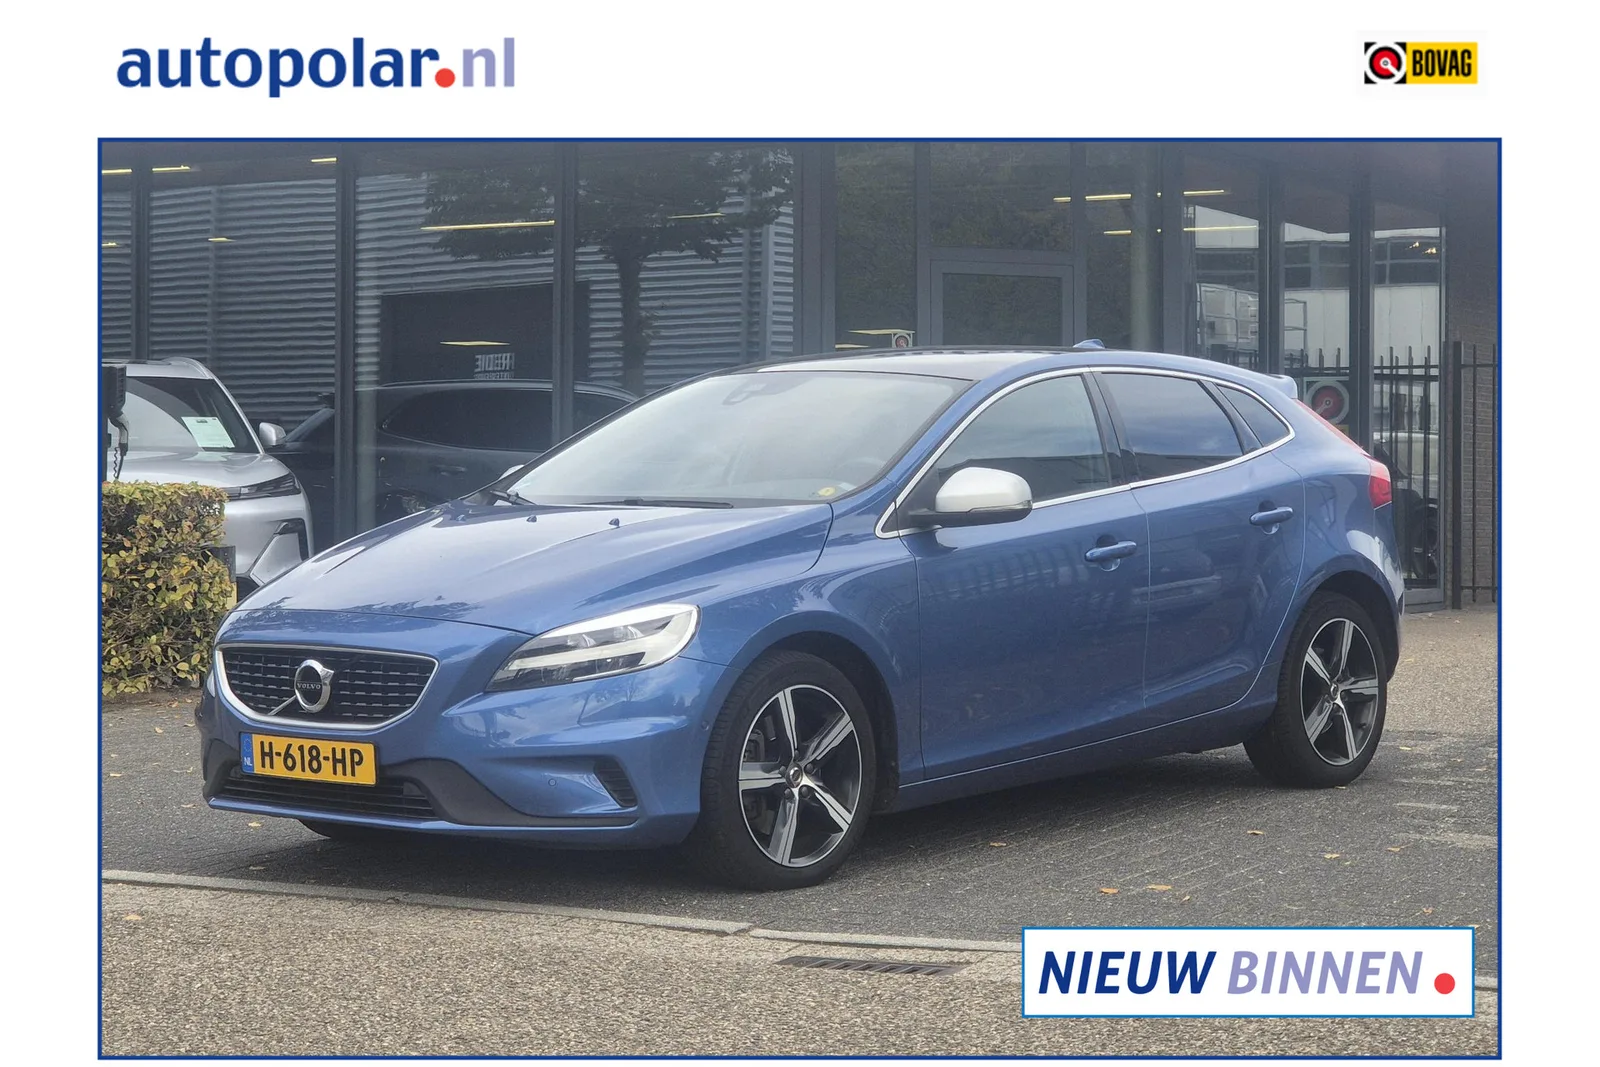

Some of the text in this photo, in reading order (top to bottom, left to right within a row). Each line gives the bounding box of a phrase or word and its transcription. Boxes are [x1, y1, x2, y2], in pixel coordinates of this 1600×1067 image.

[297, 682, 321, 690] VOLVO
[244, 740, 364, 777] NL H-618-HP
